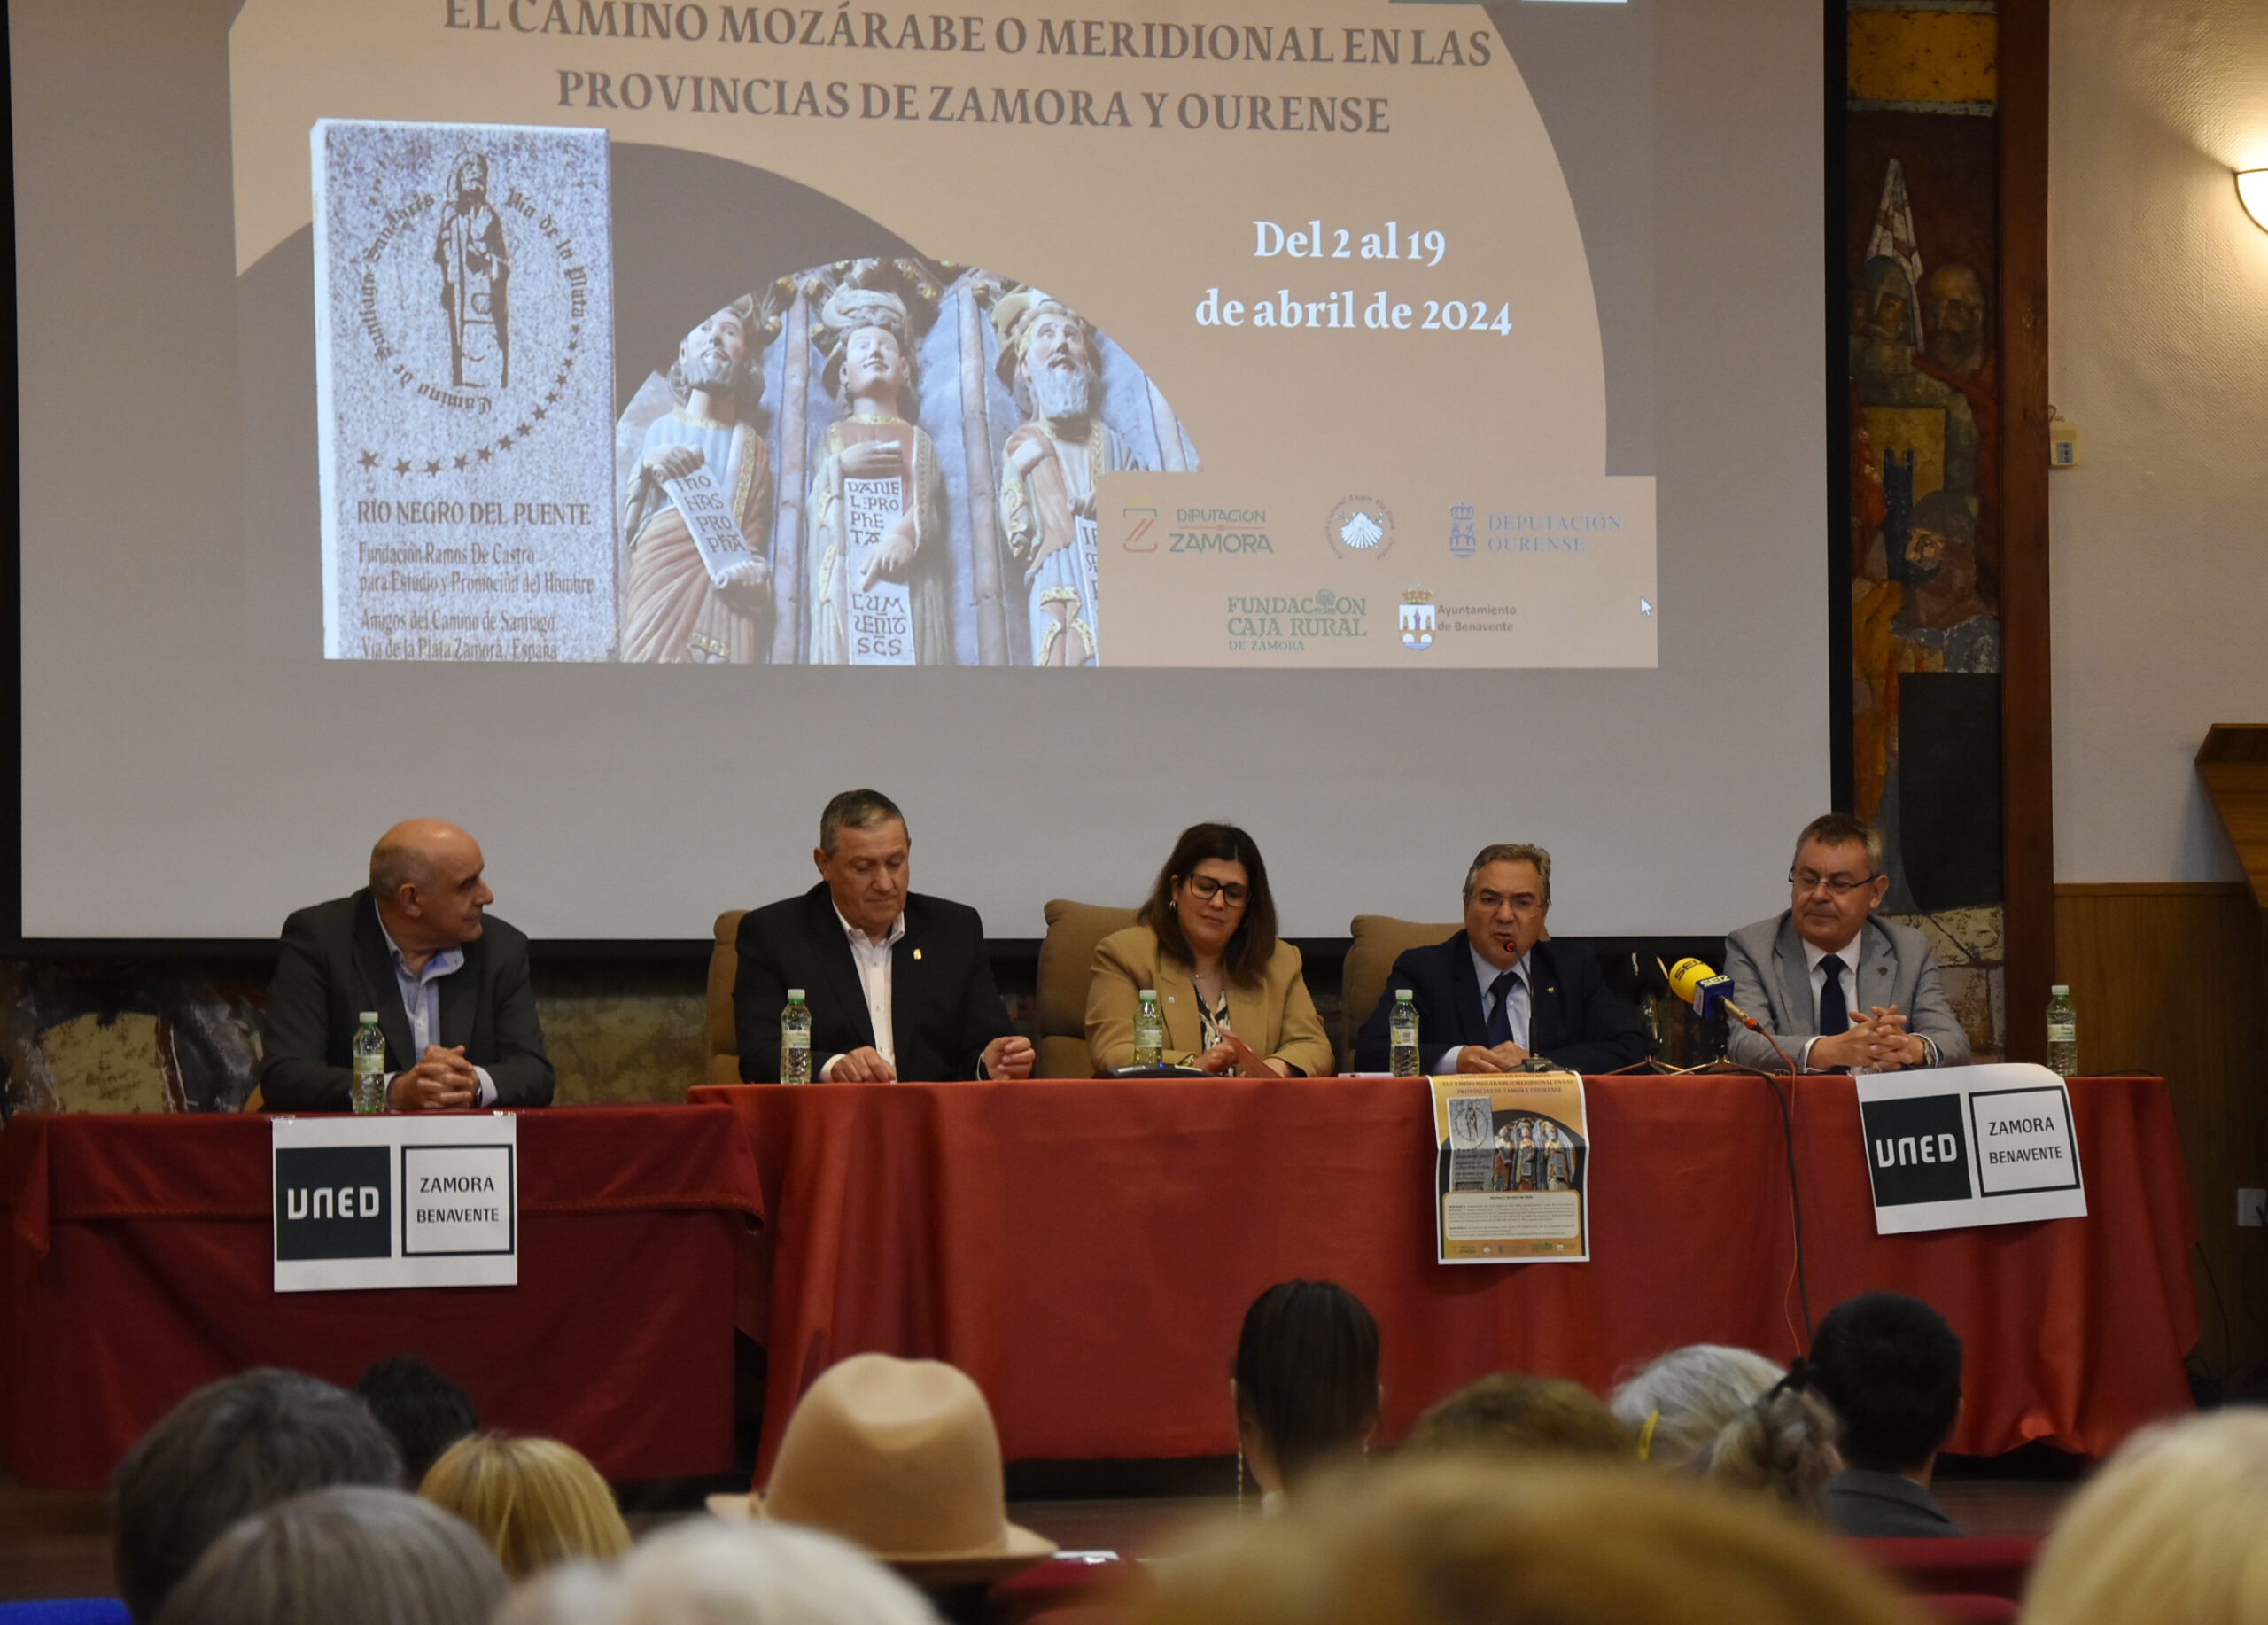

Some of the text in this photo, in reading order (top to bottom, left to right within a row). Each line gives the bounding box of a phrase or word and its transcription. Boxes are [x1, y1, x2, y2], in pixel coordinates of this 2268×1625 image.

[444, 0, 1492, 66] EL CAMINO MOZÁRABE O MERIDIONAL EN LAS
[556, 69, 1390, 133] PROVINCIAS DE ZAMORA Y OURENSE
[1253, 220, 1446, 267] Del 2 al 19
[1195, 288, 1512, 336] de abril de 2024
[396, 501, 465, 525] NEGRO
[470, 502, 509, 525] DEL
[514, 503, 594, 525] PUENTE
[1488, 512, 1623, 532] DEPUTACIÓN
[425, 542, 468, 565] Ramos
[471, 542, 490, 565] De
[493, 542, 535, 565] Castro
[1169, 533, 1274, 554] ZAMORA
[1487, 536, 1587, 553] OURENSE
[360, 575, 389, 597] para
[392, 570, 438, 595] Estudio
[523, 572, 541, 595] del
[544, 572, 595, 595] Hombre
[1437, 604, 1517, 618] Ayuntamiento
[361, 608, 556, 638] Amigos del Camino de Santiago
[1228, 618, 1367, 638] CAJA RURAL
[1437, 621, 1514, 632] de Benavente
[385, 636, 401, 659] de
[1228, 640, 1305, 652] DE ZAMORA
[1700, 975, 1731, 987] SER
[1988, 1116, 2055, 1136] ZAMORA
[1876, 1133, 1957, 1168] UNED
[1989, 1146, 2062, 1164] BENAVENTE
[420, 1176, 495, 1193] ZAMORA
[287, 1186, 380, 1220] UNED
[416, 1207, 500, 1224] BENAVENTE
